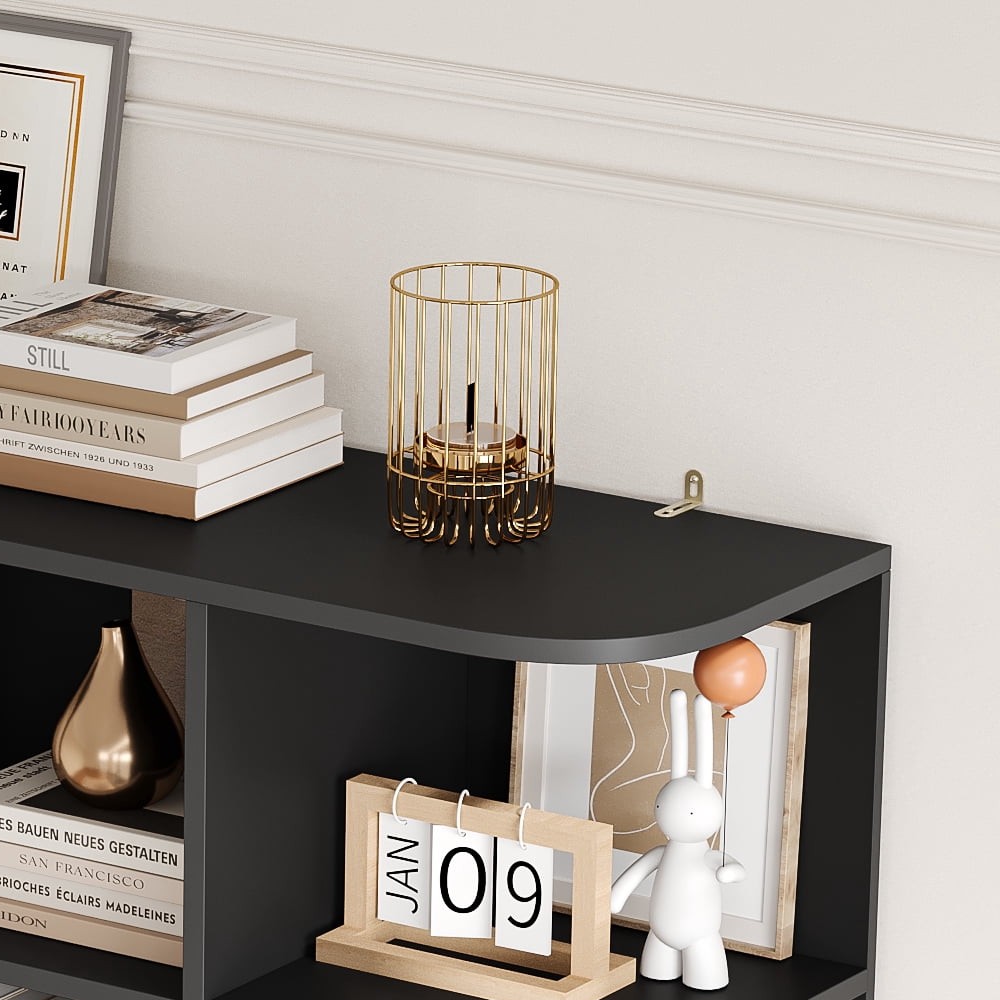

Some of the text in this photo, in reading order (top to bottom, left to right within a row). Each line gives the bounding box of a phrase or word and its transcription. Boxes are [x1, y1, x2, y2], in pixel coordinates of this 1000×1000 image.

[27, 344, 70, 372] STILL
[28, 443, 80, 459] ZWISCHEN
[83, 453, 105, 463] 1926
[108, 457, 130, 467] UND
[132, 462, 154, 472] 1933
[17, 821, 60, 842] BAUEN
[63, 830, 105, 852] NEUES
[109, 840, 178, 867] GESTALTEN
[19, 853, 145, 890] SAN FRANCISCO
[385, 834, 419, 914] JAN
[56, 887, 101, 908] ÉCLAIRS
[106, 901, 176, 925] MADELEINES
